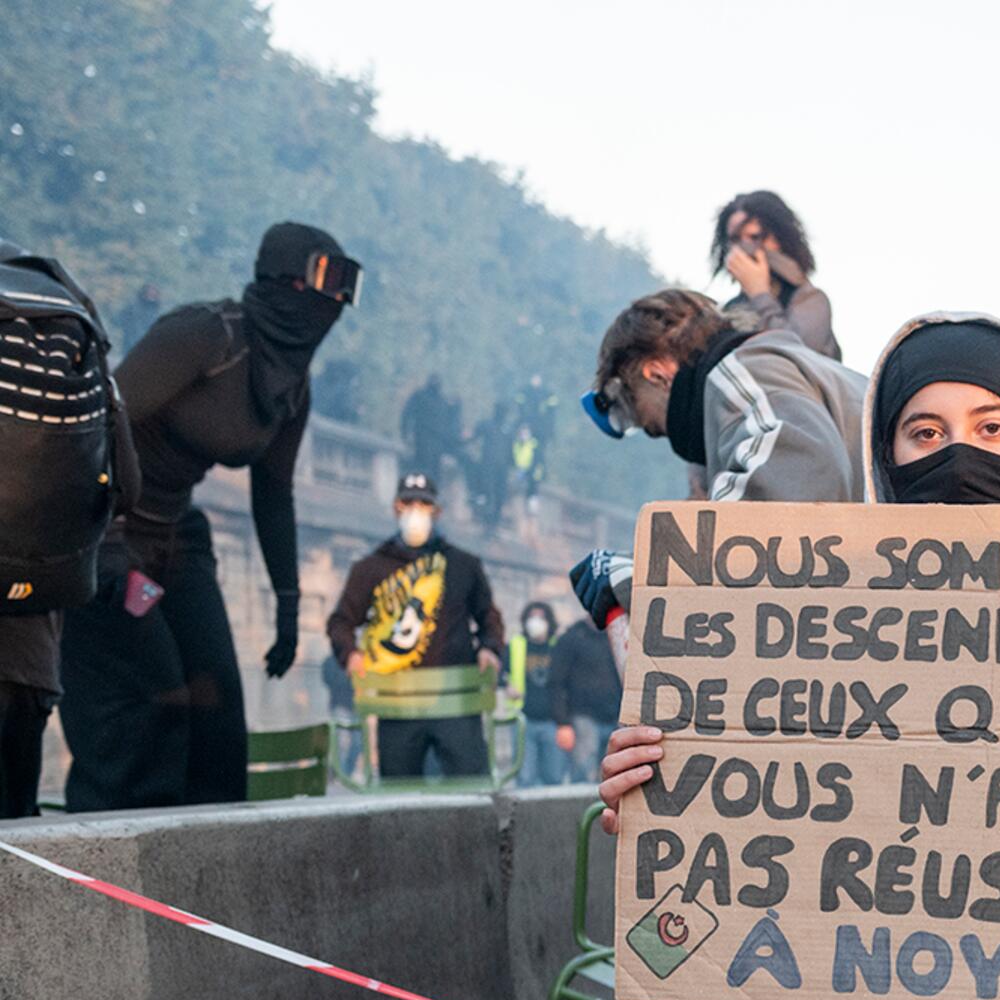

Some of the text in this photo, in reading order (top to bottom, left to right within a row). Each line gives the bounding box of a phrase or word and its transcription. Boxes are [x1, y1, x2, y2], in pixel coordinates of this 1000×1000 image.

[647, 510, 849, 588] NOUS
[643, 597, 736, 658] LES
[640, 671, 727, 734] DE
[743, 677, 908, 740] CEUX
[643, 753, 853, 822] VOUS
[636, 829, 795, 908] PAS
[727, 908, 802, 989] À
